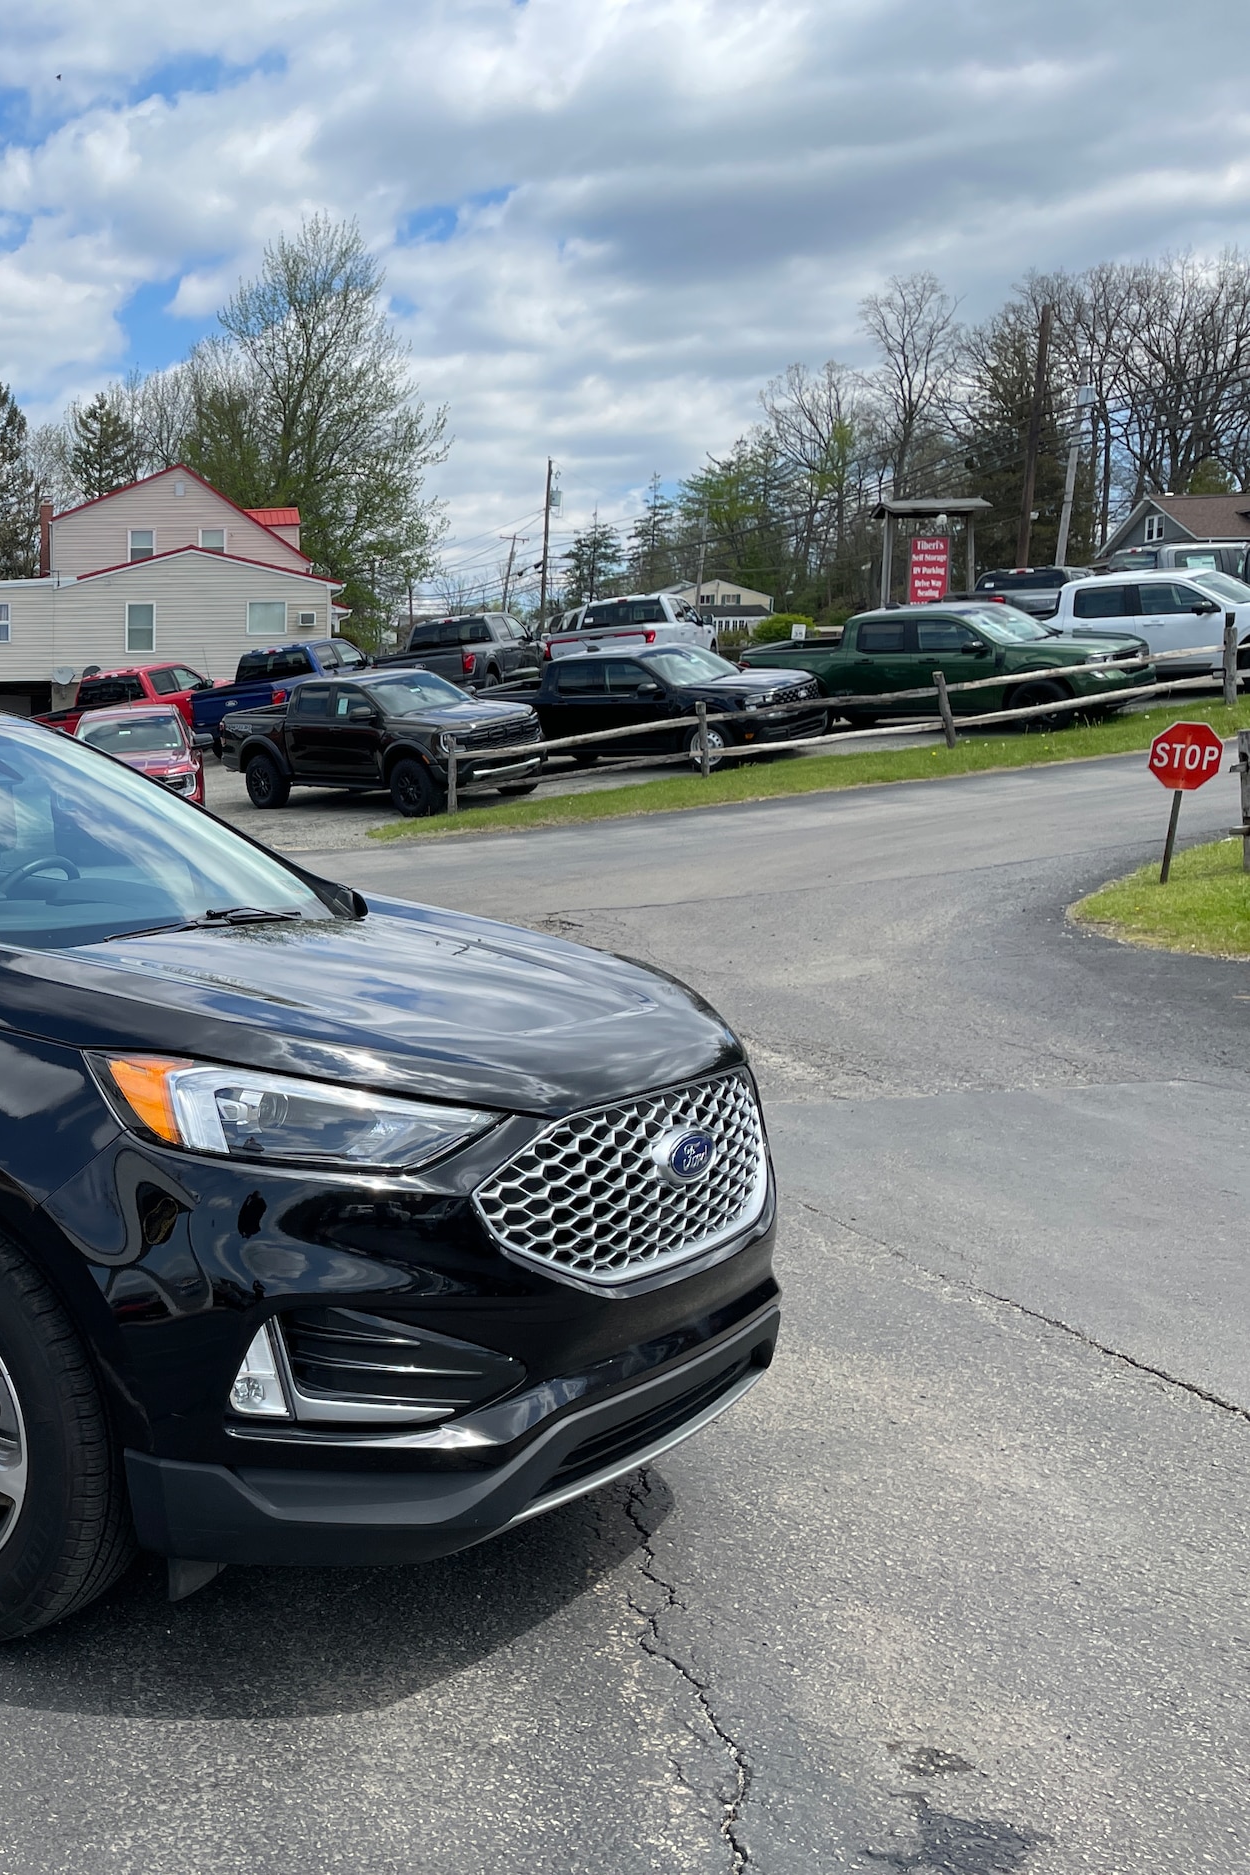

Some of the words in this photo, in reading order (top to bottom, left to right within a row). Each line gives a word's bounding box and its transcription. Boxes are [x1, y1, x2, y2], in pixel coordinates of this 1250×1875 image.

[912, 554, 924, 562] Self
[925, 554, 947, 563] Storage
[922, 566, 945, 575] Parking
[915, 579, 930, 588] Drive
[931, 579, 942, 588] Way
[1153, 742, 1219, 770] STOP
